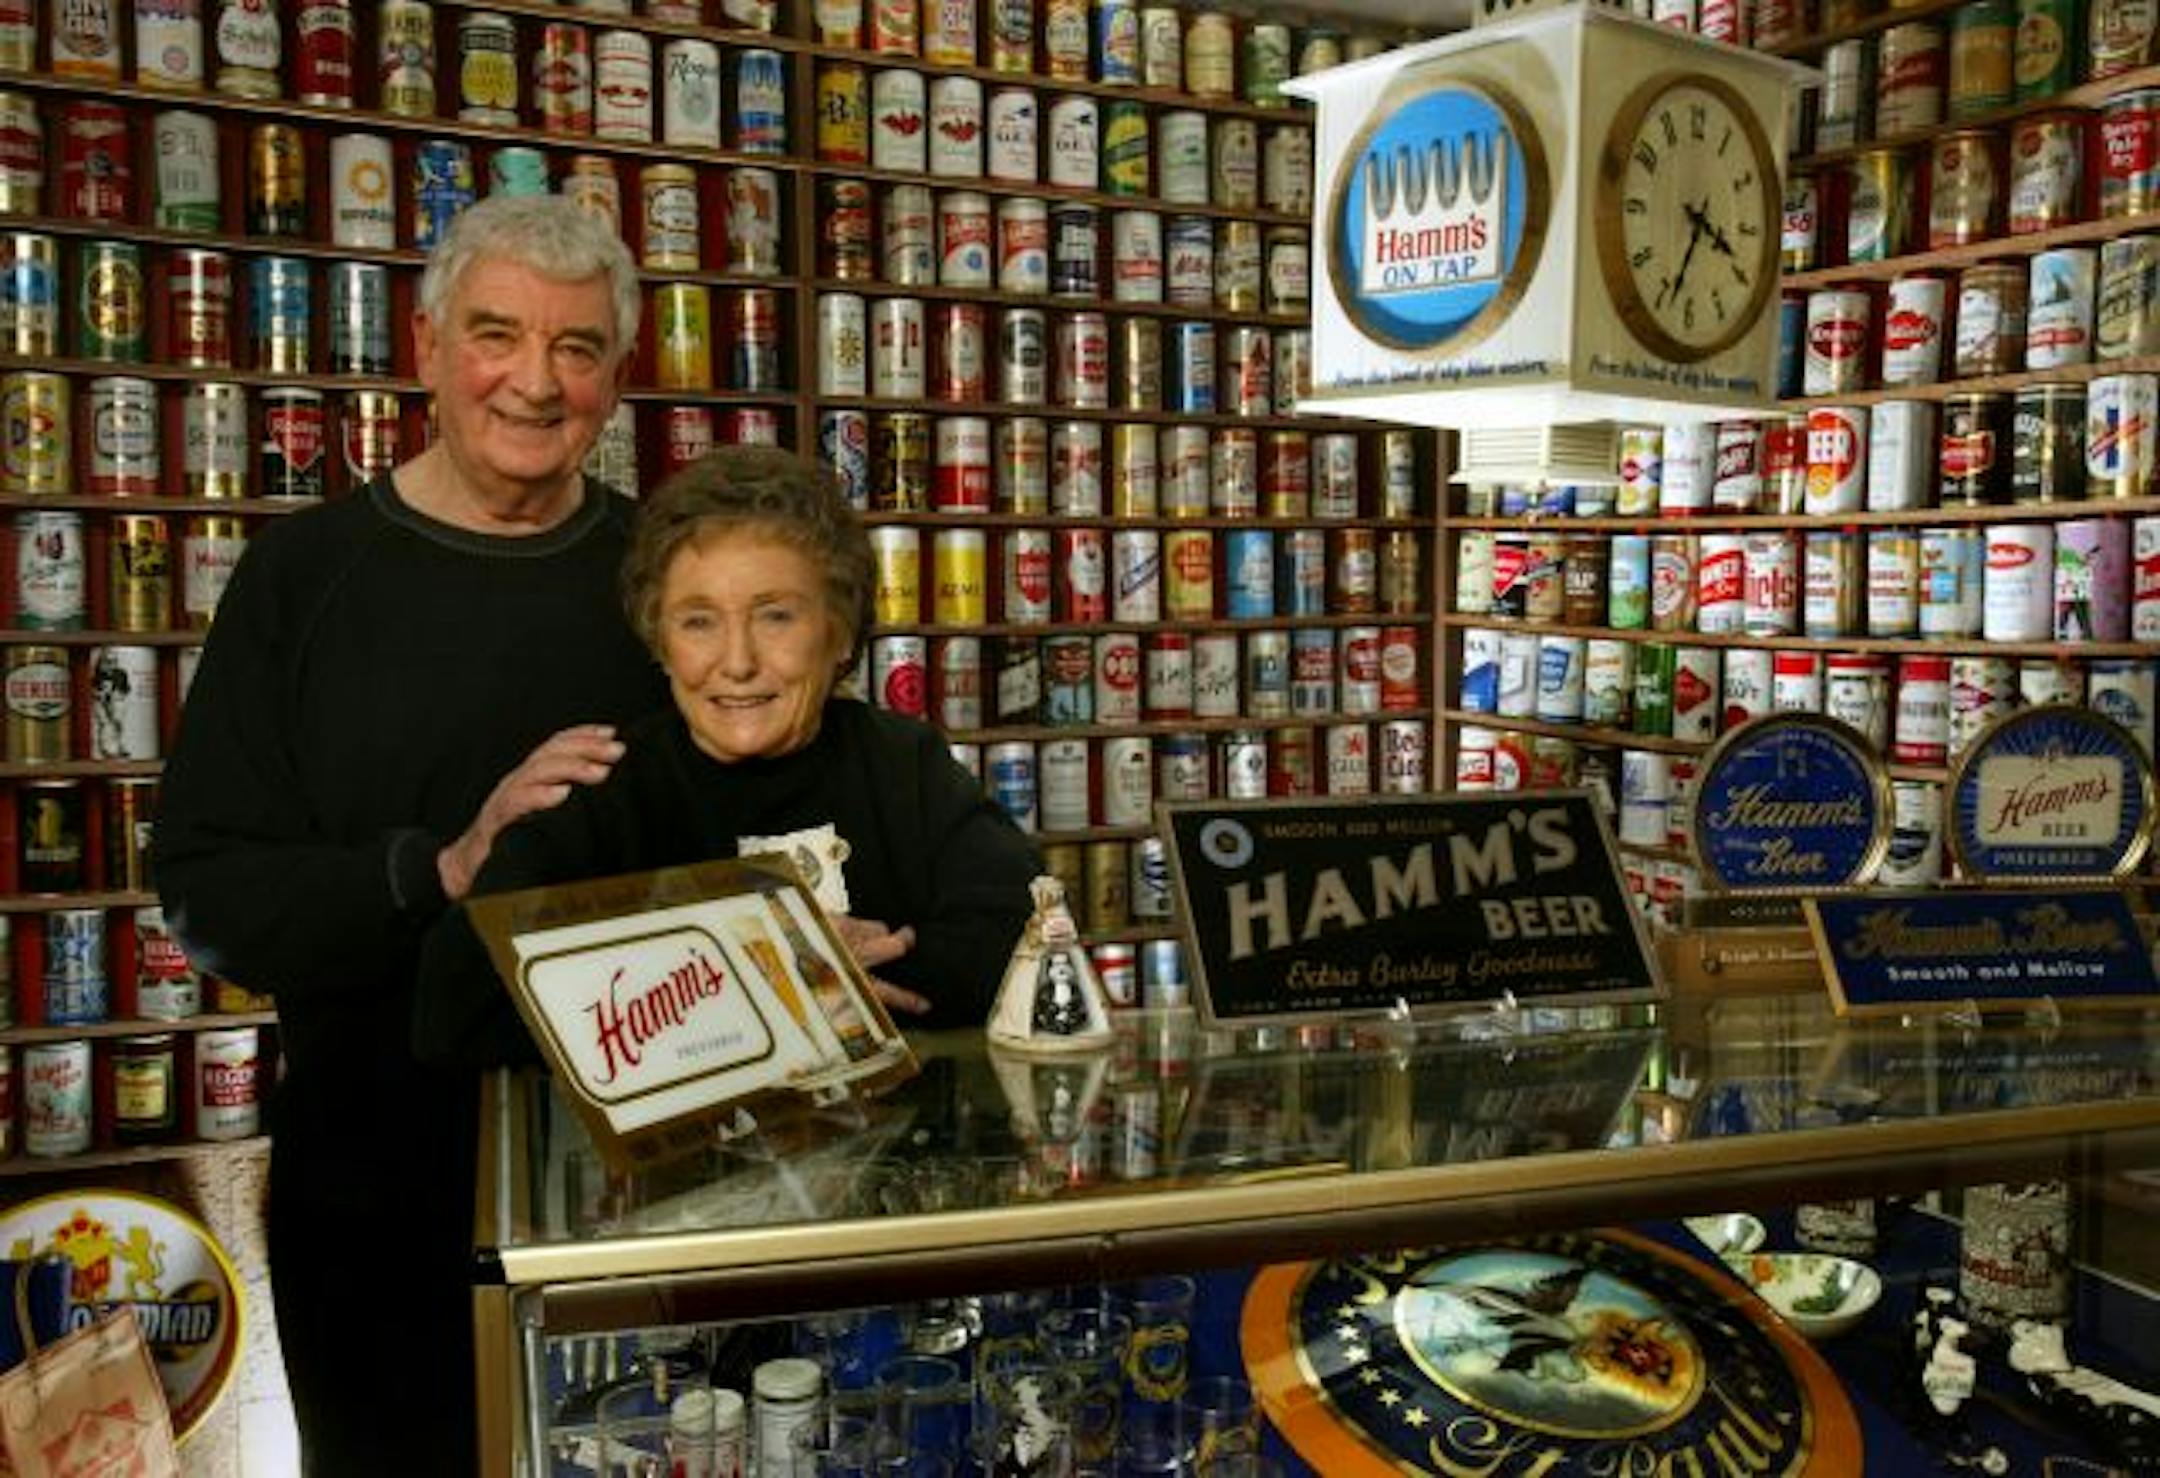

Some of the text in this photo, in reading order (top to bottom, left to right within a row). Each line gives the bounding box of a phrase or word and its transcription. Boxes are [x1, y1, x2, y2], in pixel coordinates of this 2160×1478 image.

[1376, 212, 1488, 264] Hamm's
[1383, 255, 1478, 286] ON TAP
[1707, 781, 1869, 830] Hamm's
[1745, 836, 1827, 875] Beer
[1226, 807, 1578, 961] HAMM'S
[1482, 895, 1610, 942] BEER
[1285, 948, 1596, 990] Extra Barley Goodness
[1886, 959, 2106, 981] Smooth and Mellow
[583, 947, 725, 1085] Hamm's
